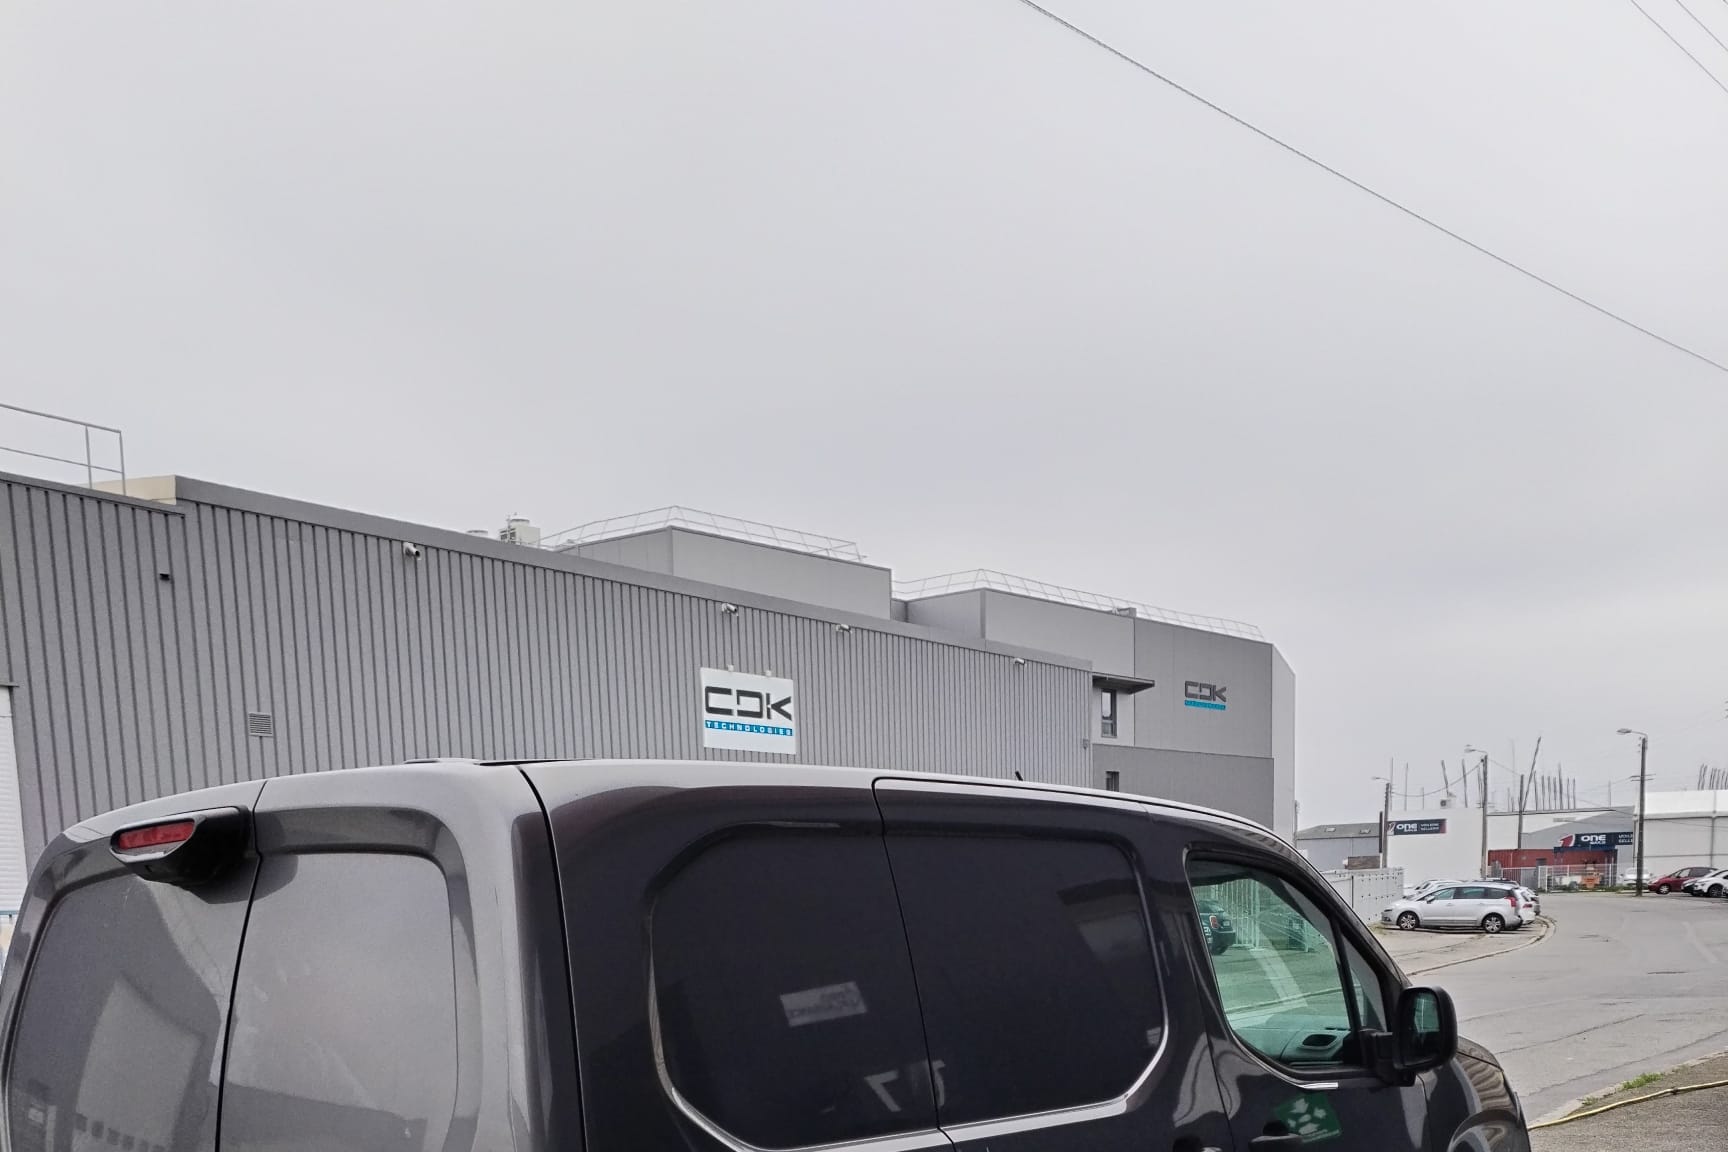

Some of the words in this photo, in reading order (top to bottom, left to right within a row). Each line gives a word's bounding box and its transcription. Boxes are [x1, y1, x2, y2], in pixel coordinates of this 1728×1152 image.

[1184, 680, 1227, 702] CDK
[704, 686, 793, 721] CDK
[705, 720, 793, 736] TECHNOLOGIES
